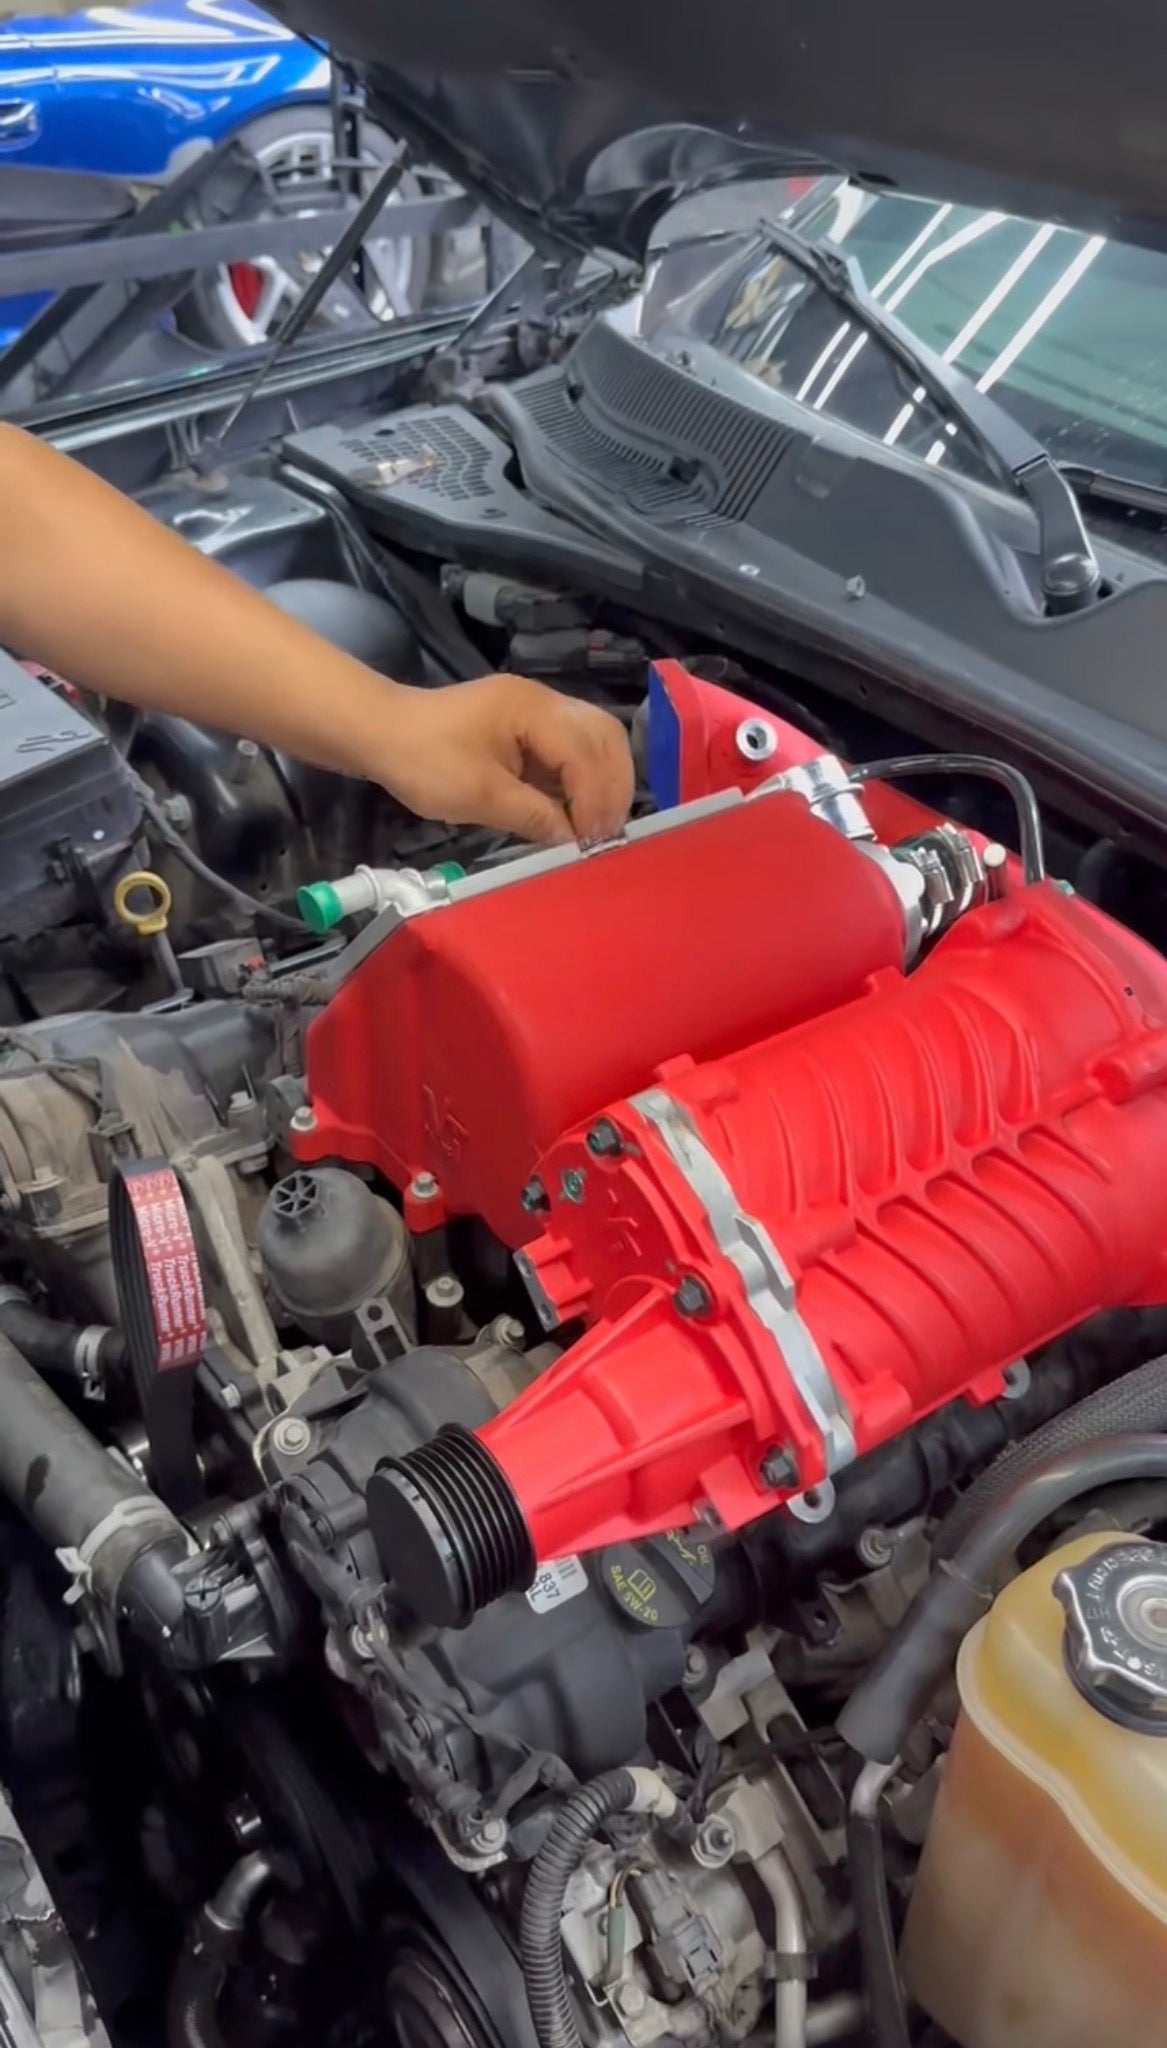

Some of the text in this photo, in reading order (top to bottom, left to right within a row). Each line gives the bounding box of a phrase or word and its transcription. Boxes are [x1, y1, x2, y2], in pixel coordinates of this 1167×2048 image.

[697, 1545, 709, 1566] OIL
[539, 1572, 560, 1599] 837
[610, 1564, 658, 1621] SAE 5W-20
